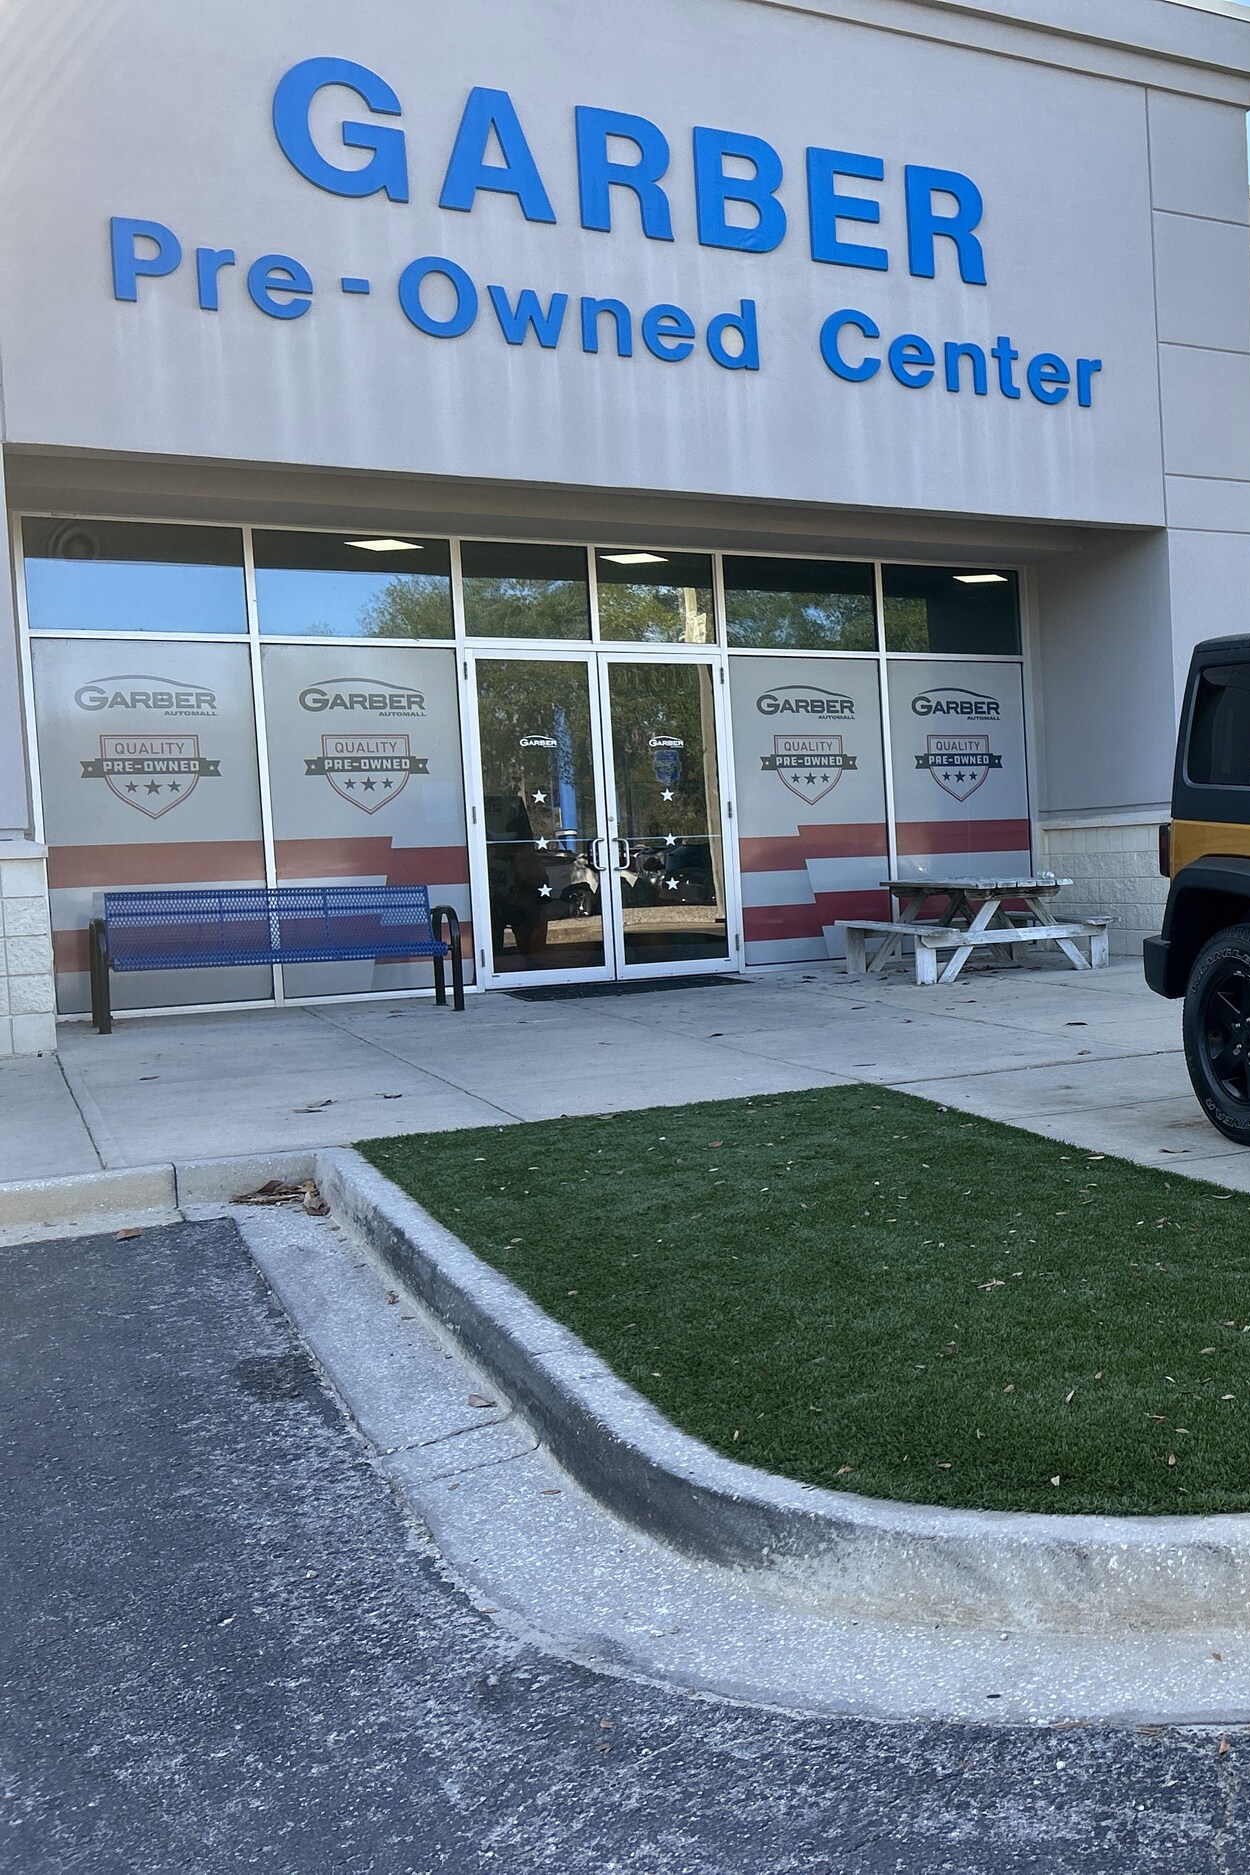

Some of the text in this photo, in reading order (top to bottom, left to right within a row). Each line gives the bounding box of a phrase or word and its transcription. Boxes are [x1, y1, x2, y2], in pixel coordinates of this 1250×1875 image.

[272, 56, 988, 286] GARBER
[110, 216, 1104, 408] Pre-Owned Center
[74, 685, 217, 711] GARBER
[299, 687, 426, 712] GARBER
[756, 694, 855, 716] GARBER
[911, 696, 1001, 716] GARBER
[114, 742, 185, 755] QUALITY
[334, 741, 397, 754] QUALITY
[519, 738, 558, 747] GARBER
[784, 741, 833, 752] QUALITY
[936, 741, 980, 751] QUALITY
[102, 760, 200, 773] PRE-OWNED
[324, 758, 411, 770] PRE-OWNED
[775, 756, 844, 767] PRE-OWNED
[928, 755, 990, 765] PRE-OWNED
